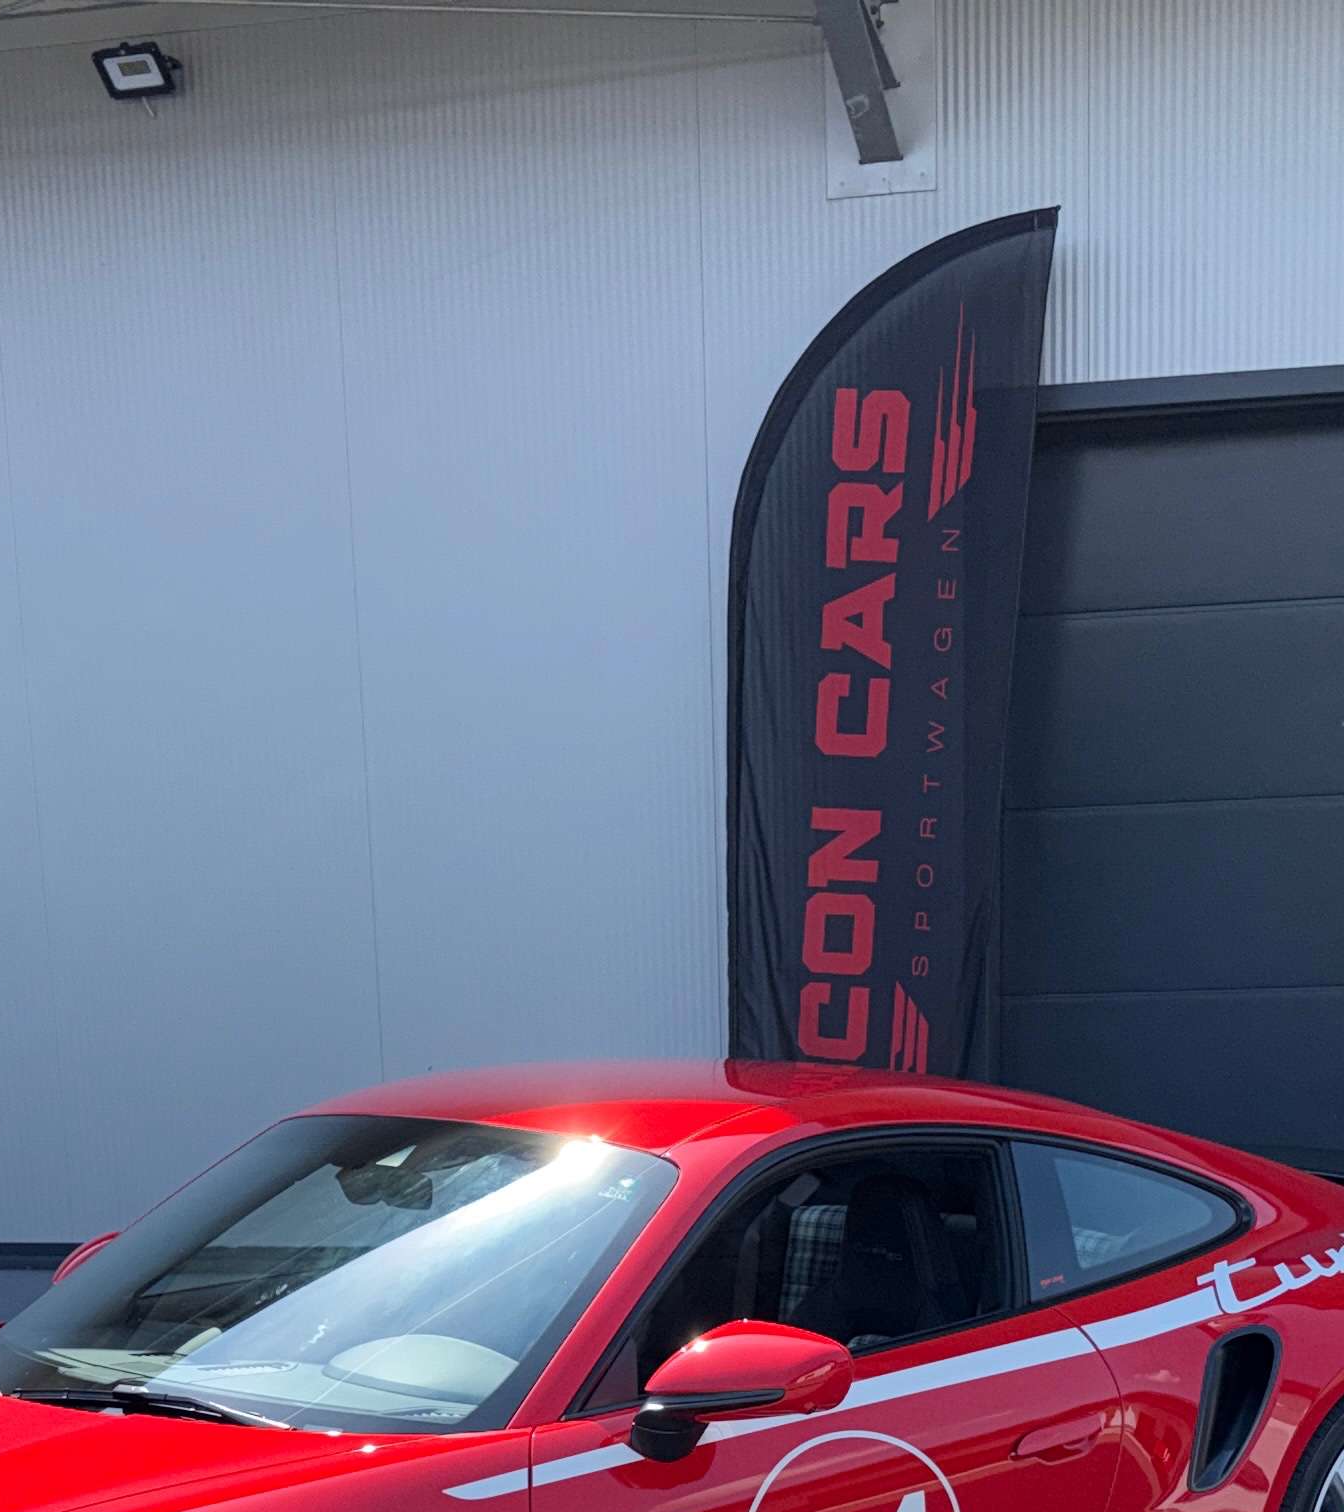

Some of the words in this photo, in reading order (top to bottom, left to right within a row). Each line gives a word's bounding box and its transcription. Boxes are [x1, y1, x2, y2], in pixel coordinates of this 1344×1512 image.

[814, 386, 911, 760] CARS
[911, 528, 961, 977] SPORTWAGEN
[798, 806, 882, 1062] CON
